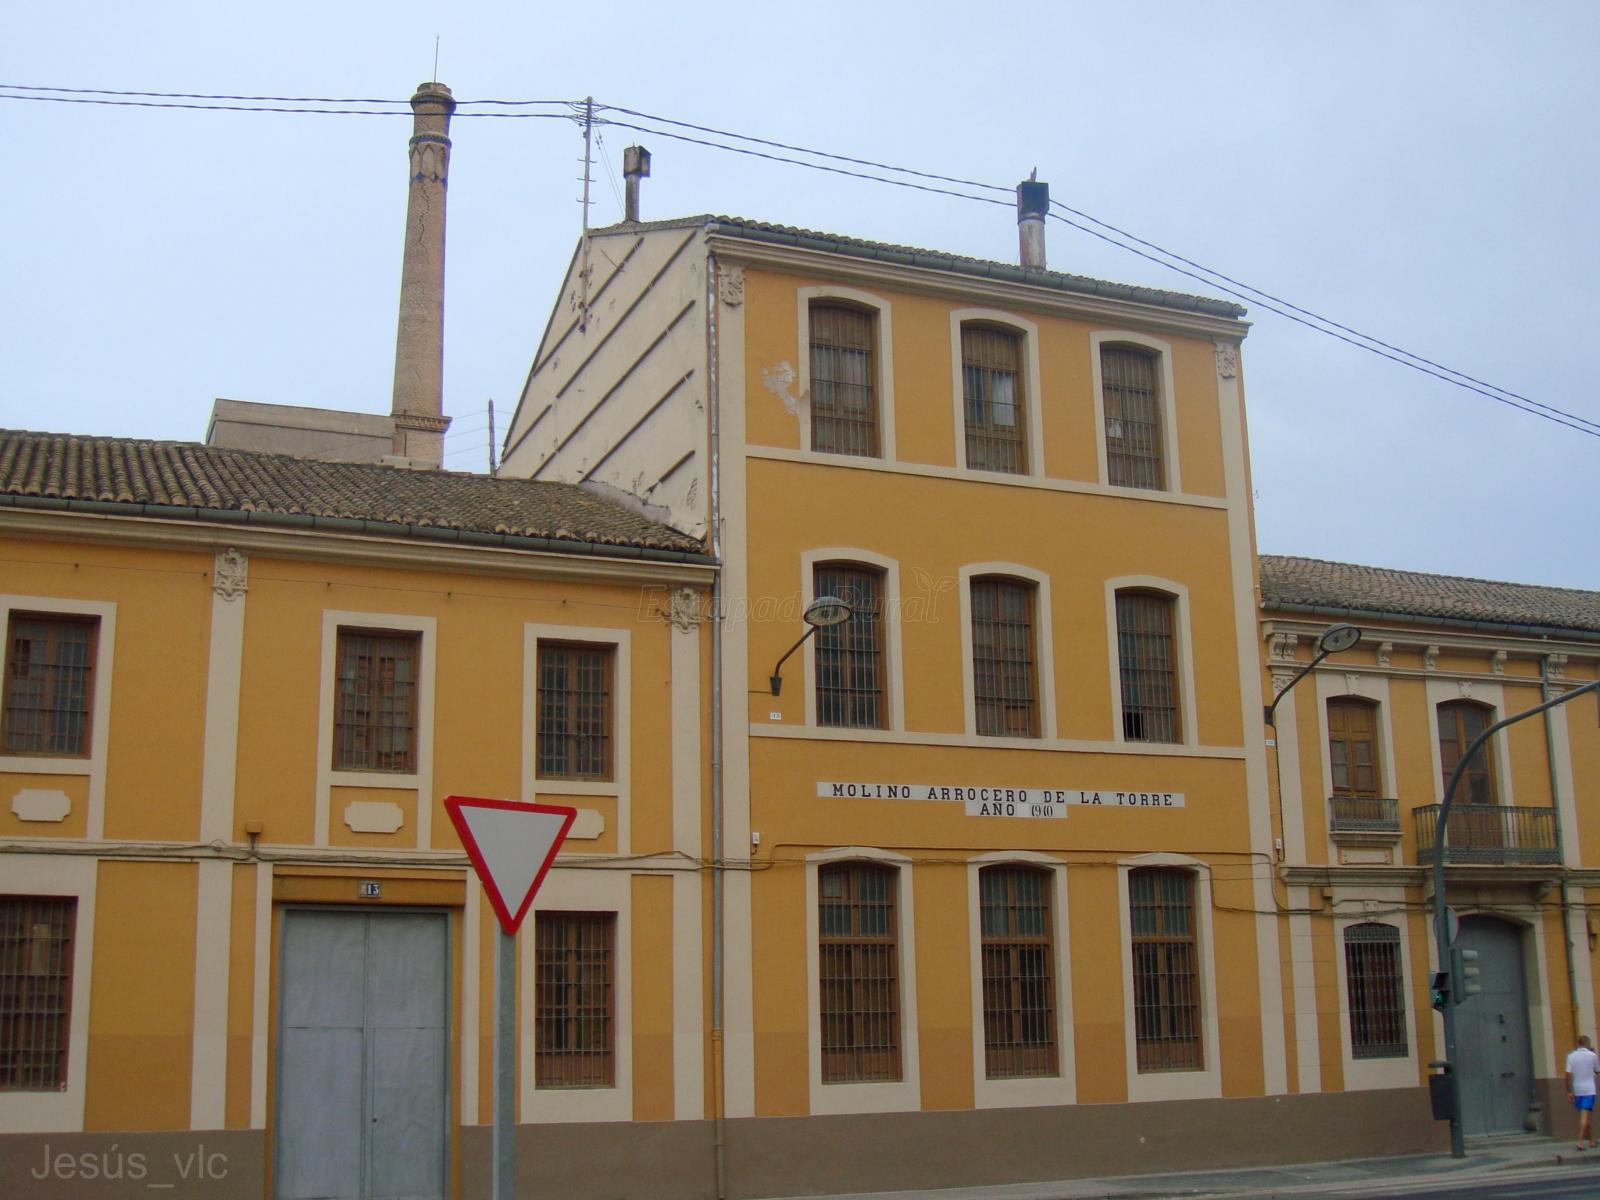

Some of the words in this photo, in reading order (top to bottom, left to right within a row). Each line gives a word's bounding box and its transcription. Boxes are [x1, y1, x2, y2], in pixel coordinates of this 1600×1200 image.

[832, 784, 911, 799] MOLINO
[927, 787, 1028, 803] ARROCERO
[1043, 791, 1065, 804] DE
[1080, 792, 1102, 805] LA
[1116, 793, 1173, 806] TORRE
[1031, 804, 1053, 818] 1910
